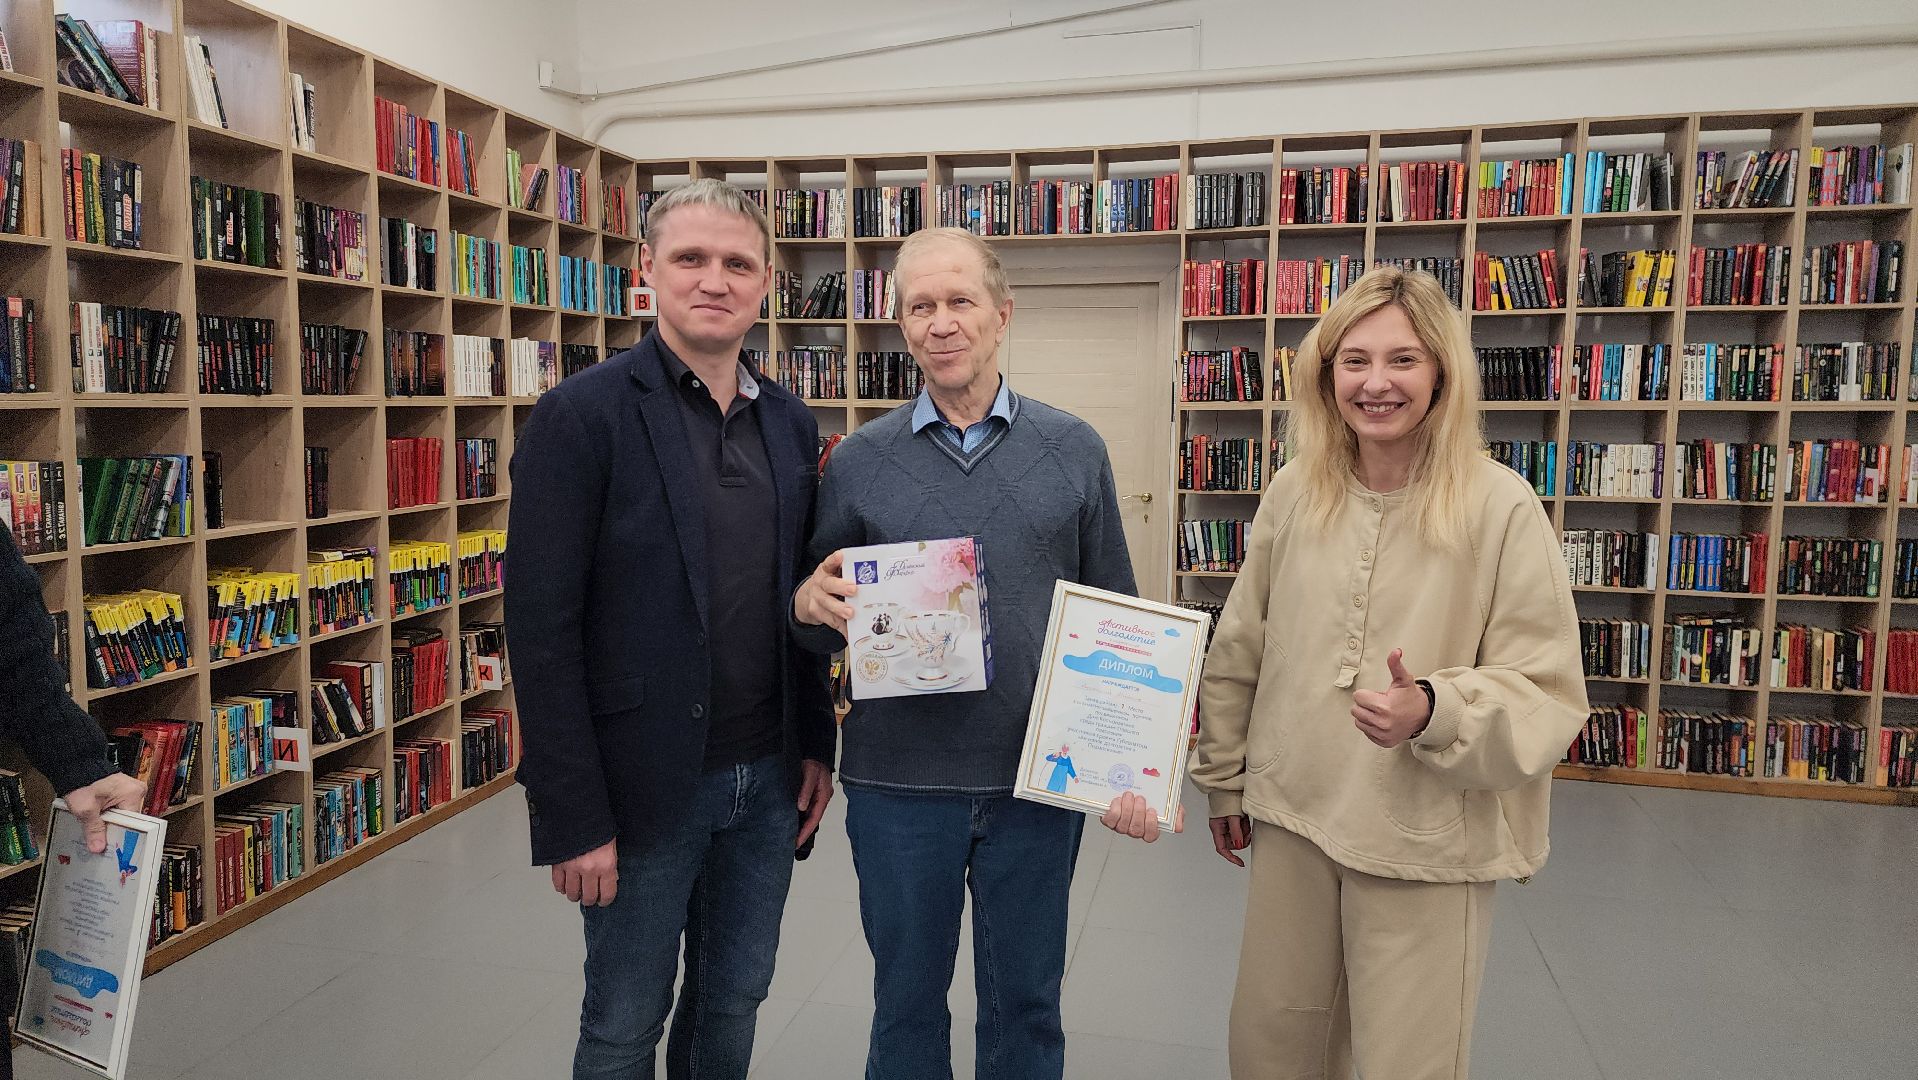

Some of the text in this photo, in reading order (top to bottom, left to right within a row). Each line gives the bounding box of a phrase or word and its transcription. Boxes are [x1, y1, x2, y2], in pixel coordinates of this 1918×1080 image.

[123, 194, 133, 232] КИЛЛЕР
[638, 295, 648, 310] В
[1097, 627, 1157, 646] долголетие
[1098, 617, 1156, 637] Активное
[1098, 657, 1154, 680] ДИПЛОМ
[279, 740, 295, 762] И
